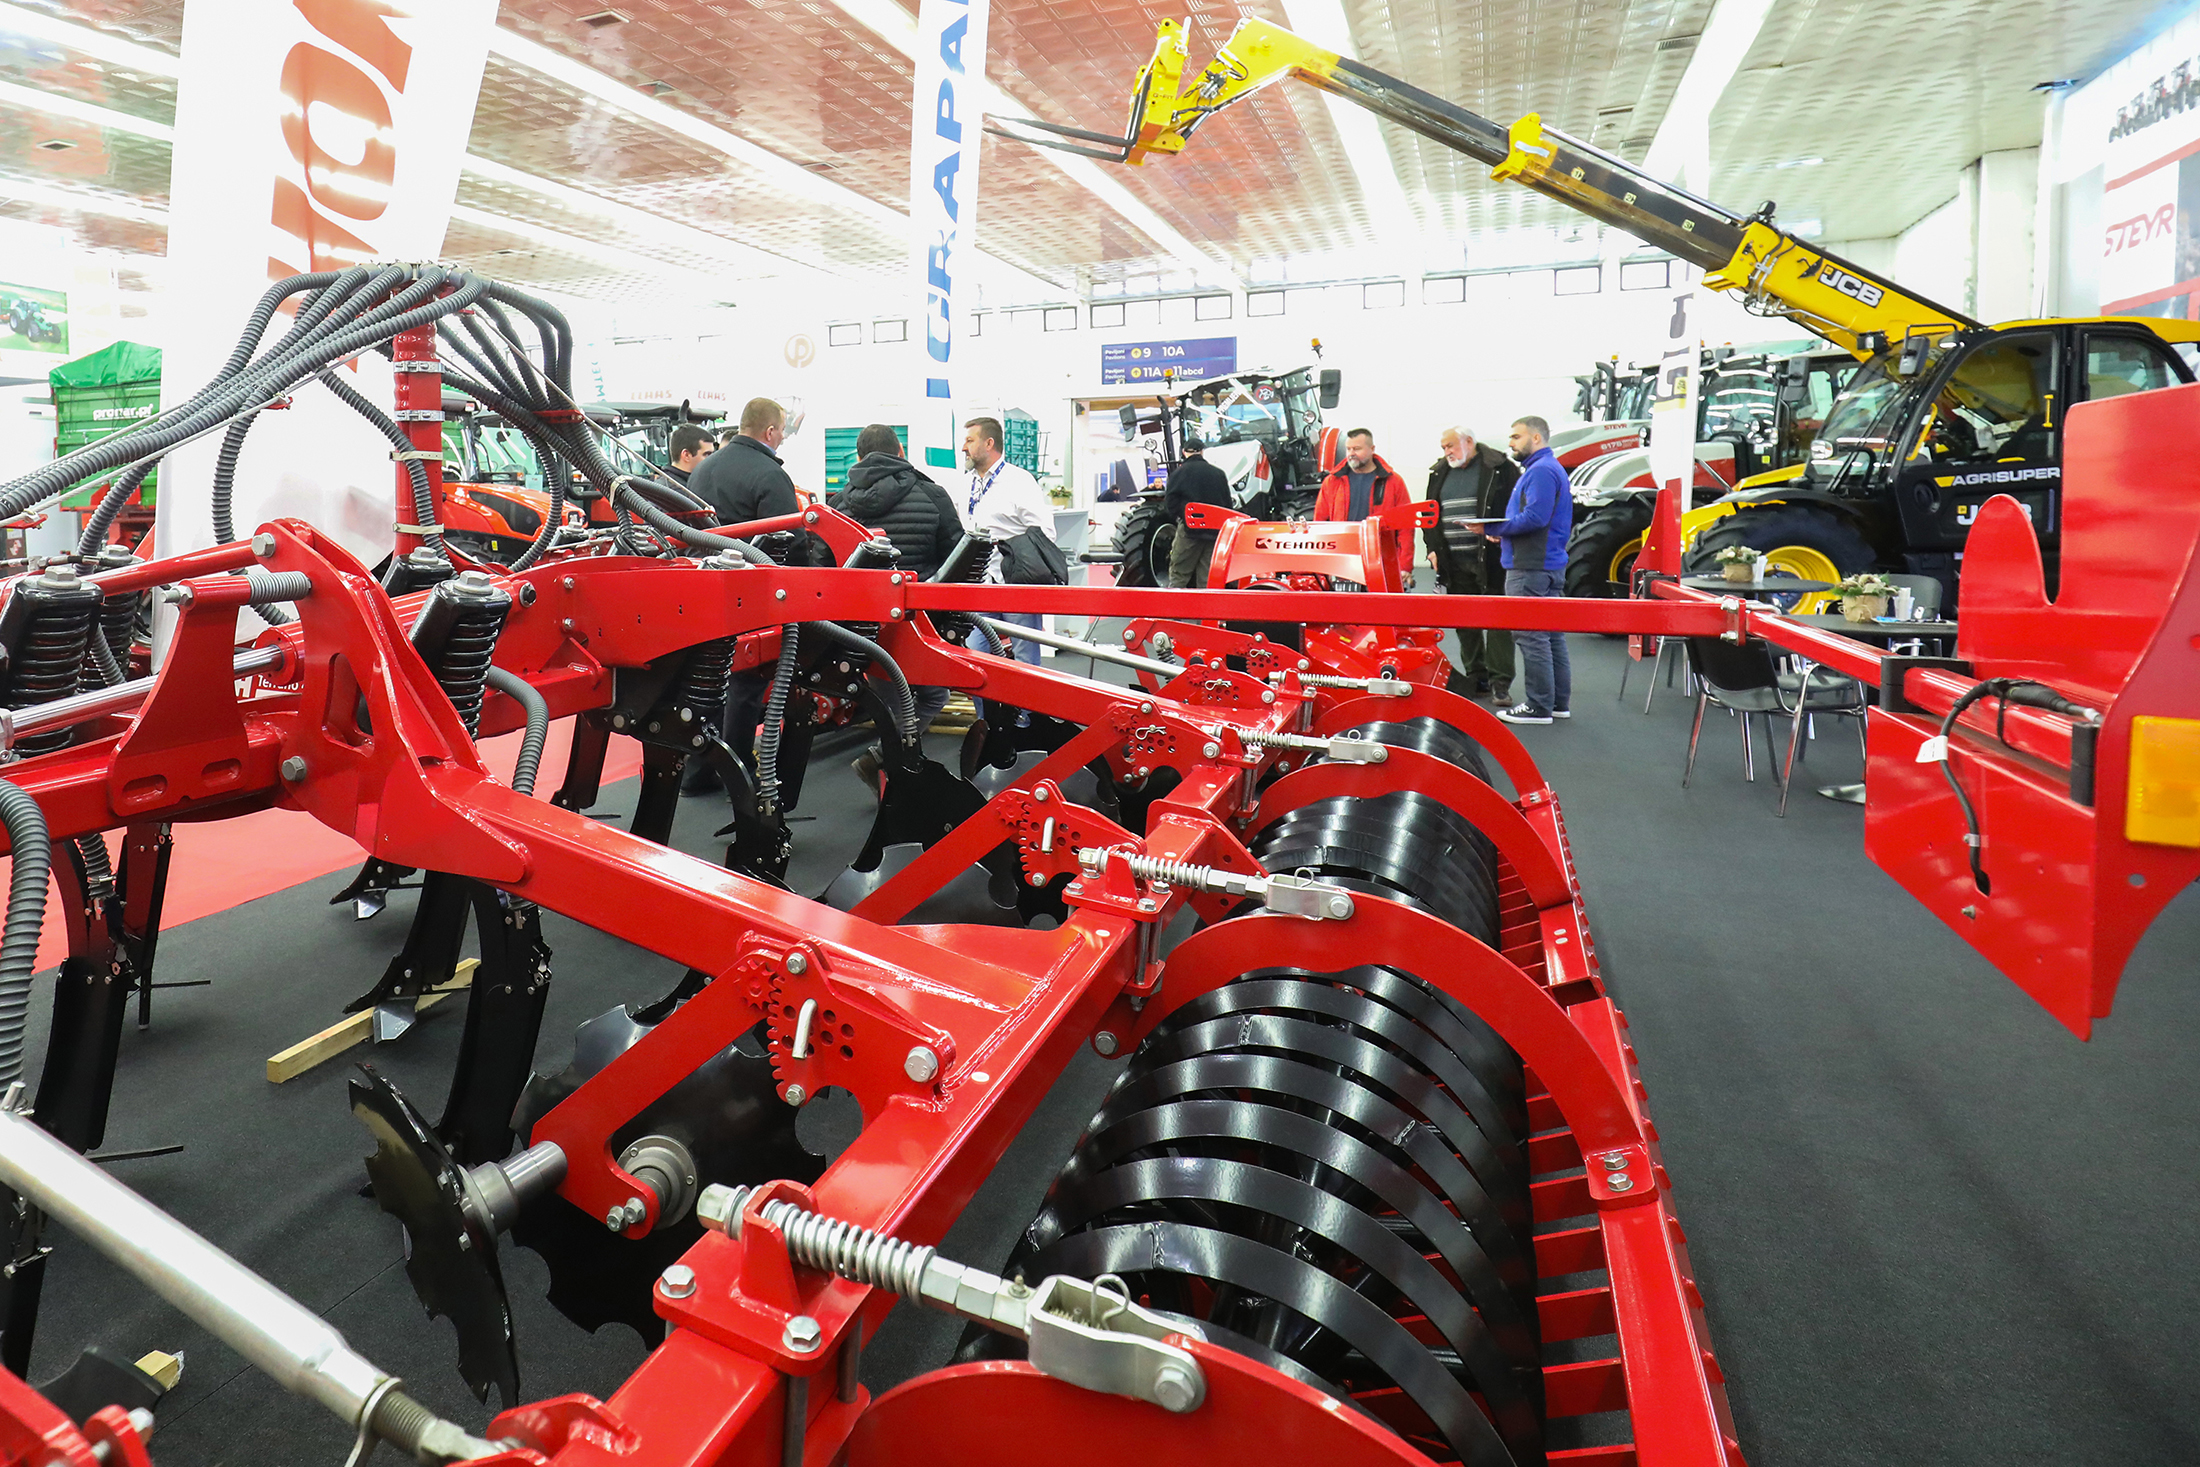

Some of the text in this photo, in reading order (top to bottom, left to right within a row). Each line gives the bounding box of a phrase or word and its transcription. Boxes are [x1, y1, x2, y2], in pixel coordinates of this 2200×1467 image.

[2104, 202, 2175, 257] STEYR
[1819, 267, 1884, 307] JCB
[1143, 348, 1152, 358] 9
[1162, 346, 1185, 357] 10A
[1143, 367, 1162, 377] 11A
[1173, 365, 1204, 376] 11abcd
[1952, 467, 2060, 486] AGRISUPER
[1275, 541, 1337, 550] TEHNOS
